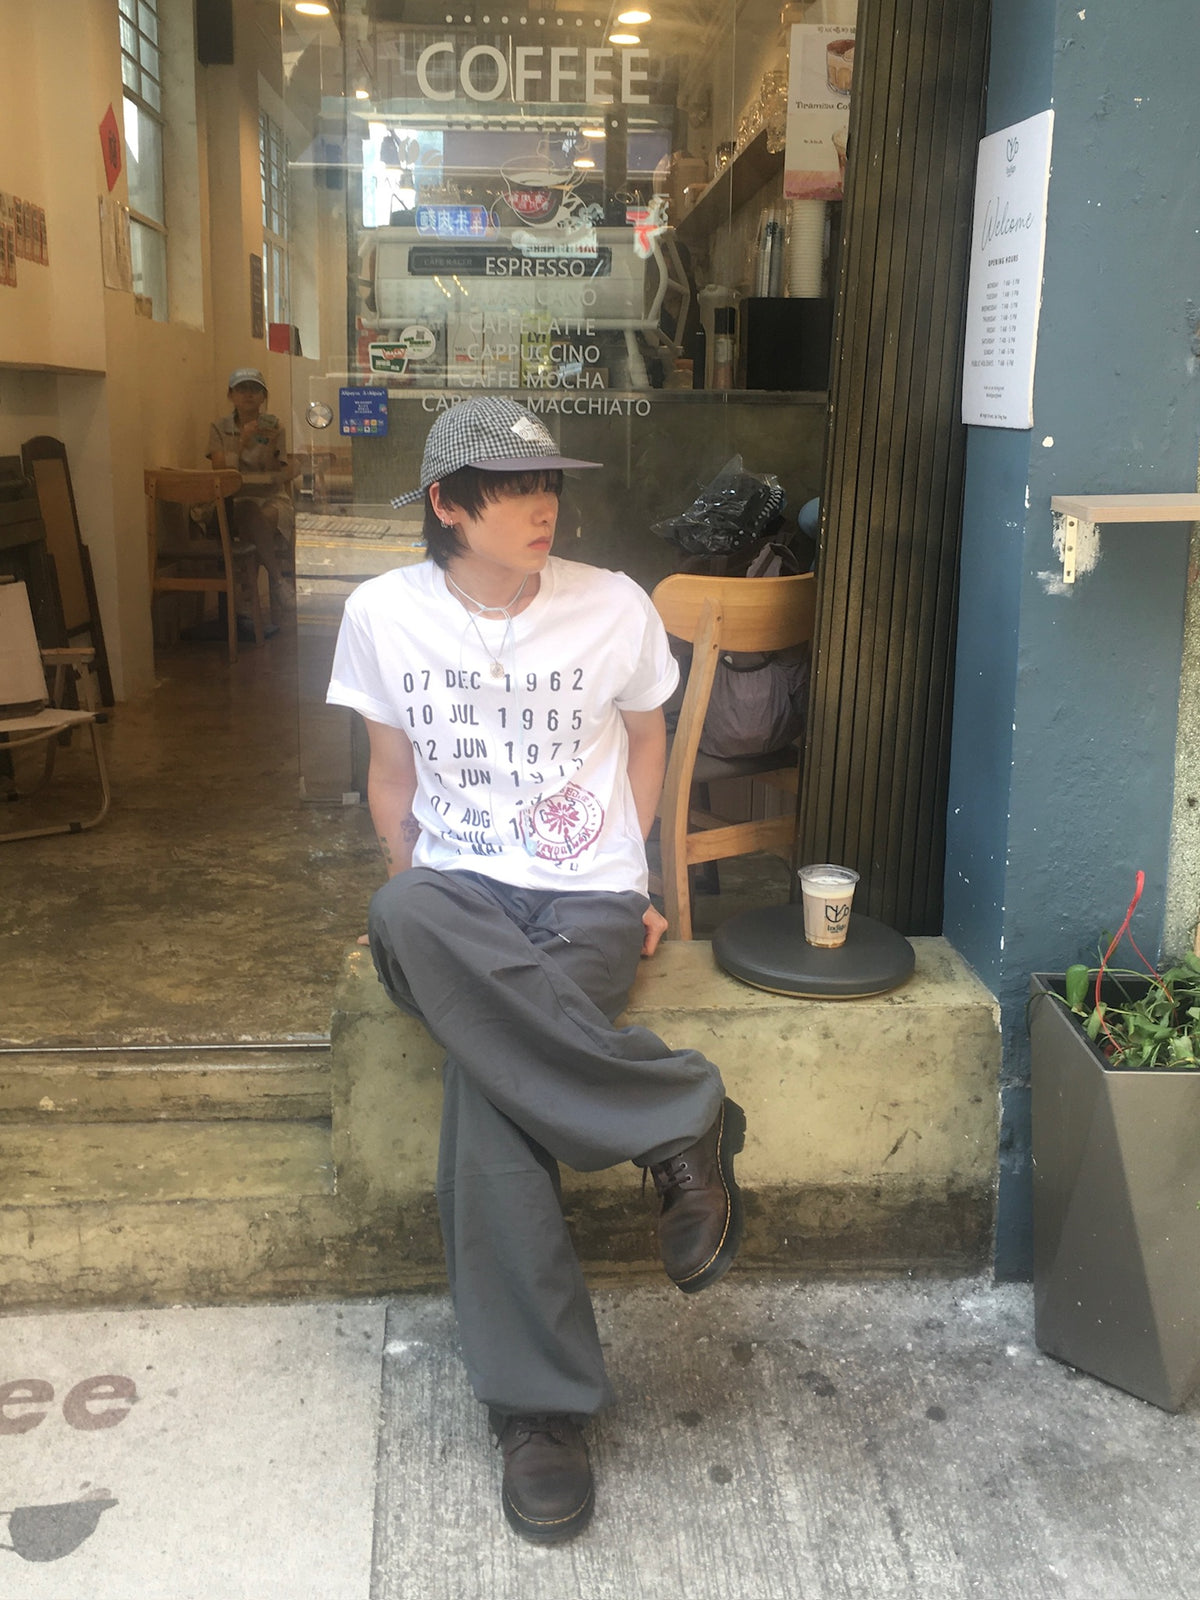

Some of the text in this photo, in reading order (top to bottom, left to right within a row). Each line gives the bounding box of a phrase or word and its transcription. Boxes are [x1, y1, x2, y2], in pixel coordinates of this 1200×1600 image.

[417, 42, 650, 104] COFFEE
[982, 196, 1034, 251] Welcome
[486, 256, 586, 278] ESPRESSO
[538, 316, 596, 336] LATTE
[467, 343, 600, 363] CAPPUCCINO
[459, 371, 605, 389] CAFFE MOCHA
[527, 397, 651, 417] MACCHIATO
[403, 668, 583, 693] 07 DEC 1962
[406, 704, 582, 731] 10 JUL 1965
[453, 738, 487, 759] JUN
[504, 739, 581, 764] 1971
[459, 768, 491, 789] JUN
[461, 808, 490, 828] AUG
